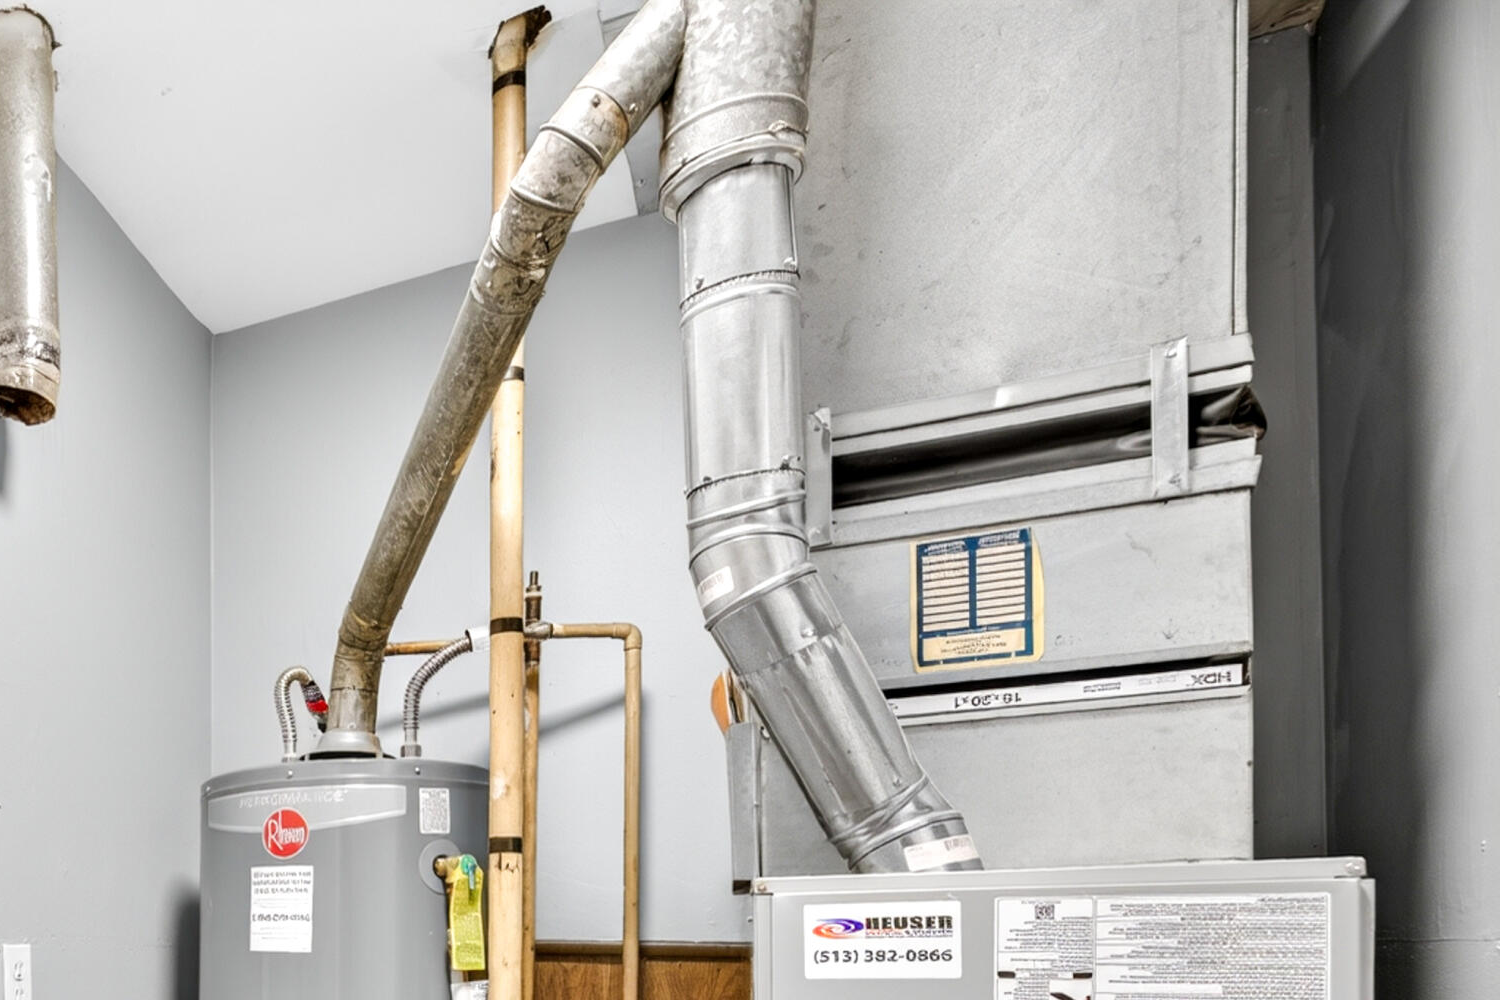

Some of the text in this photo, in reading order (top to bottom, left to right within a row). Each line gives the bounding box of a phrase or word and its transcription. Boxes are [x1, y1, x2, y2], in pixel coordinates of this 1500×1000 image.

[1191, 671, 1232, 685] HDX
[864, 915, 953, 930] HEUSER
[813, 949, 859, 964] (513)
